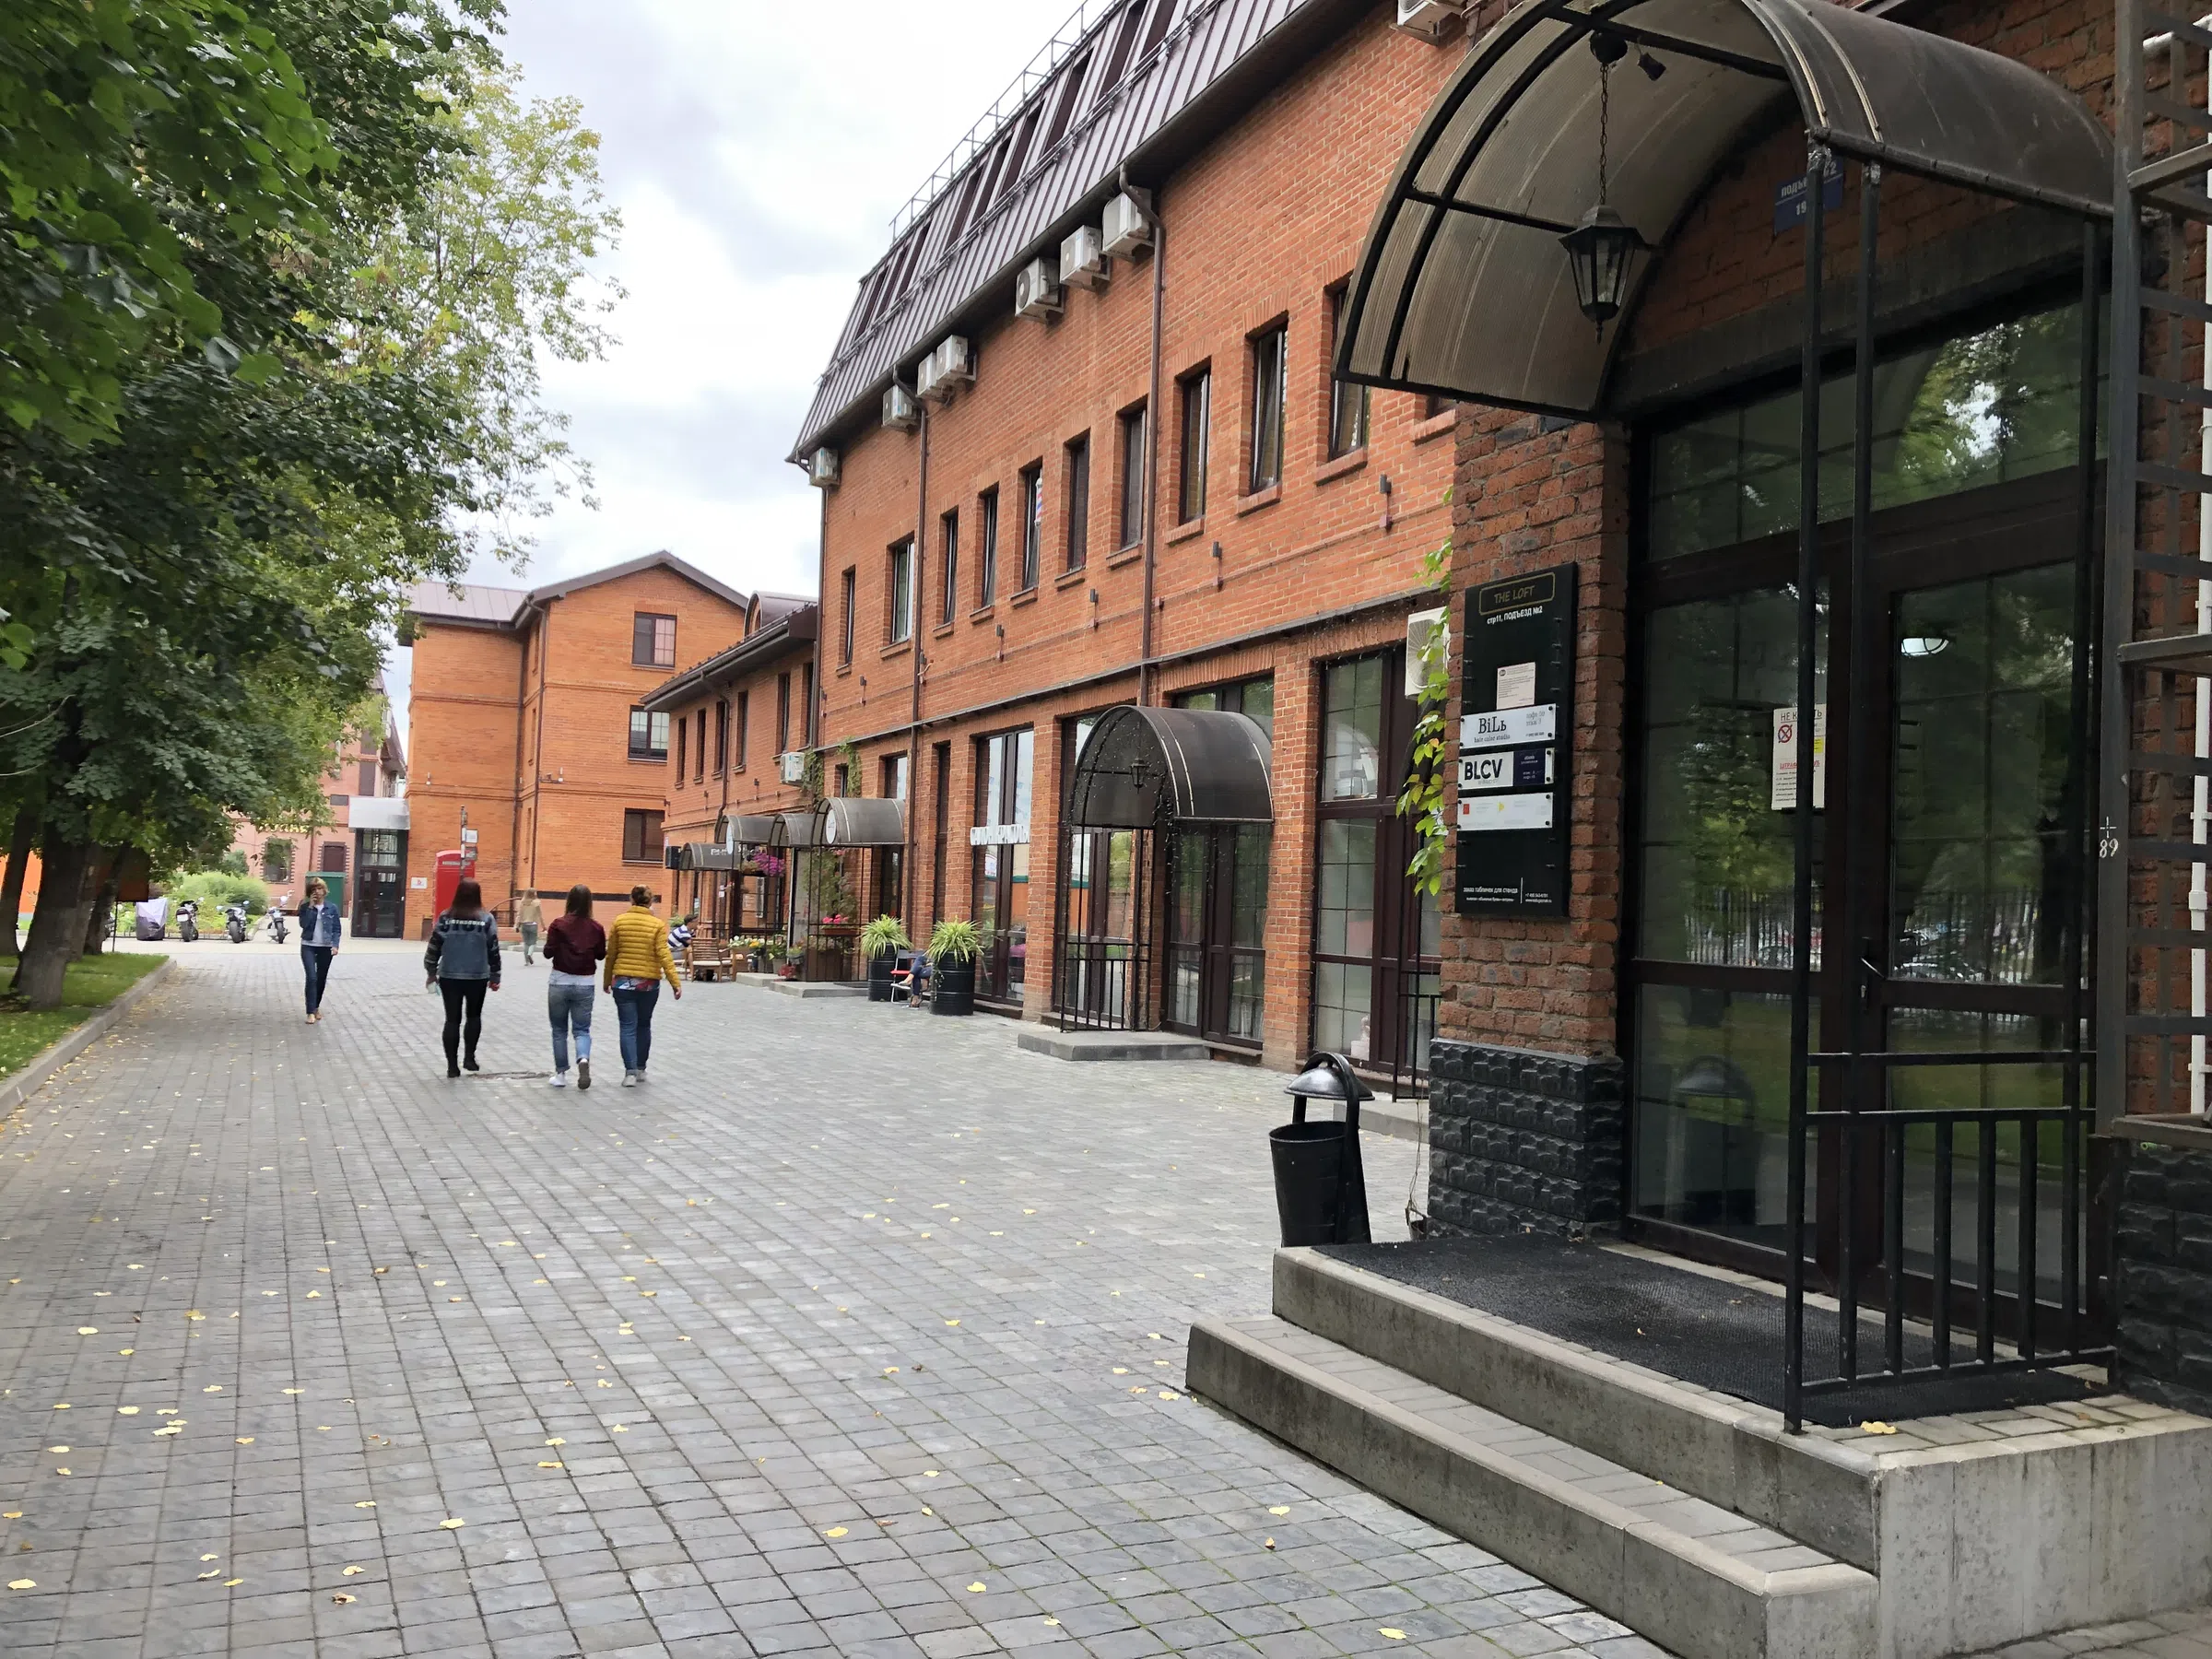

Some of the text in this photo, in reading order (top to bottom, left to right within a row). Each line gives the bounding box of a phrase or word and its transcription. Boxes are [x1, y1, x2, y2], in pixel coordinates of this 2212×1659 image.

[1494, 585, 1535, 604] THE LOFT
[1504, 607, 1532, 621] ПОДЪЕЗД
[1781, 712, 1791, 722] НЕ
[1464, 759, 1502, 781] BLCV
[2099, 838, 2119, 858] 89
